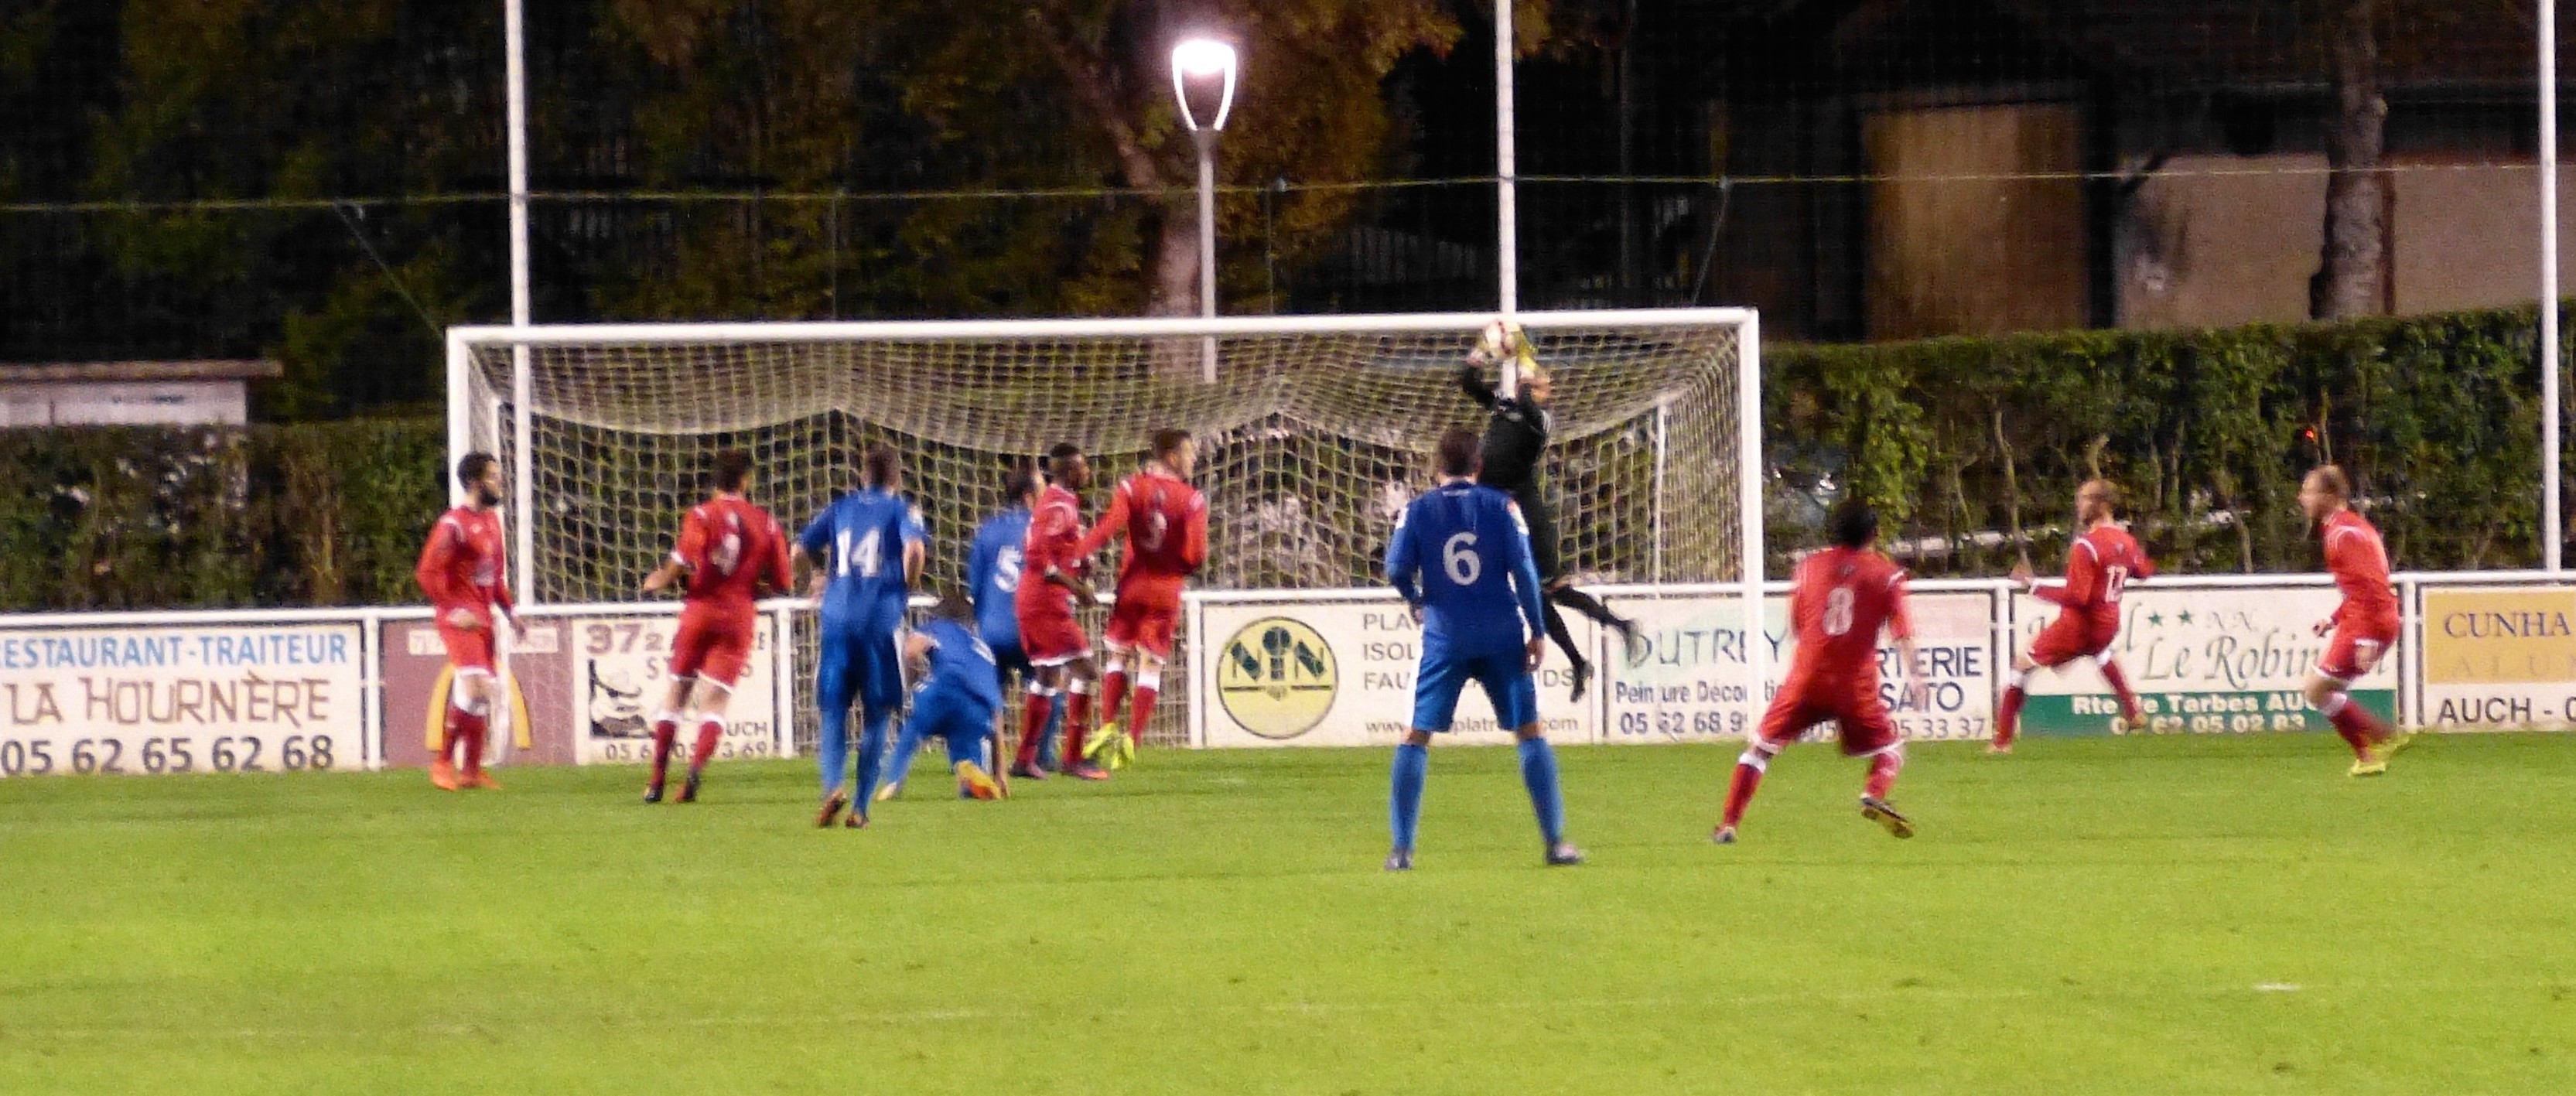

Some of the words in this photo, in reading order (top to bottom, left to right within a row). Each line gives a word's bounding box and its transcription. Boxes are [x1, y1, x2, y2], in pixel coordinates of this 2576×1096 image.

[837, 528, 880, 577] 14
[1443, 531, 1481, 586] 6
[994, 545, 1022, 592] 5
[1363, 613, 1414, 630] PLA
[1823, 586, 1855, 636] 8
[2443, 612, 2572, 638] CUNHA
[0, 633, 347, 668] ESTAURANT-TRAITEUR
[1363, 643, 1415, 661] ISOL
[2138, 636, 2191, 680] Le
[1364, 672, 1411, 690] FAU
[1615, 679, 1691, 704] Peinure
[2, 682, 63, 725] LA
[2071, 694, 2119, 715] Rte
[2167, 692, 2260, 713] Tarbes
[2438, 698, 2532, 724] AUCH
[726, 721, 767, 736] UCH
[1620, 712, 1648, 734] 05
[1693, 711, 1722, 733] 68
[1922, 718, 1949, 739] 33
[1958, 718, 1986, 739] 37
[2192, 715, 2225, 733] 05
[2233, 714, 2265, 733] 02
[1, 740, 53, 773] 05
[73, 738, 124, 773] 62
[142, 737, 193, 773] 65
[211, 736, 262, 771] 62
[282, 735, 334, 770] 68
